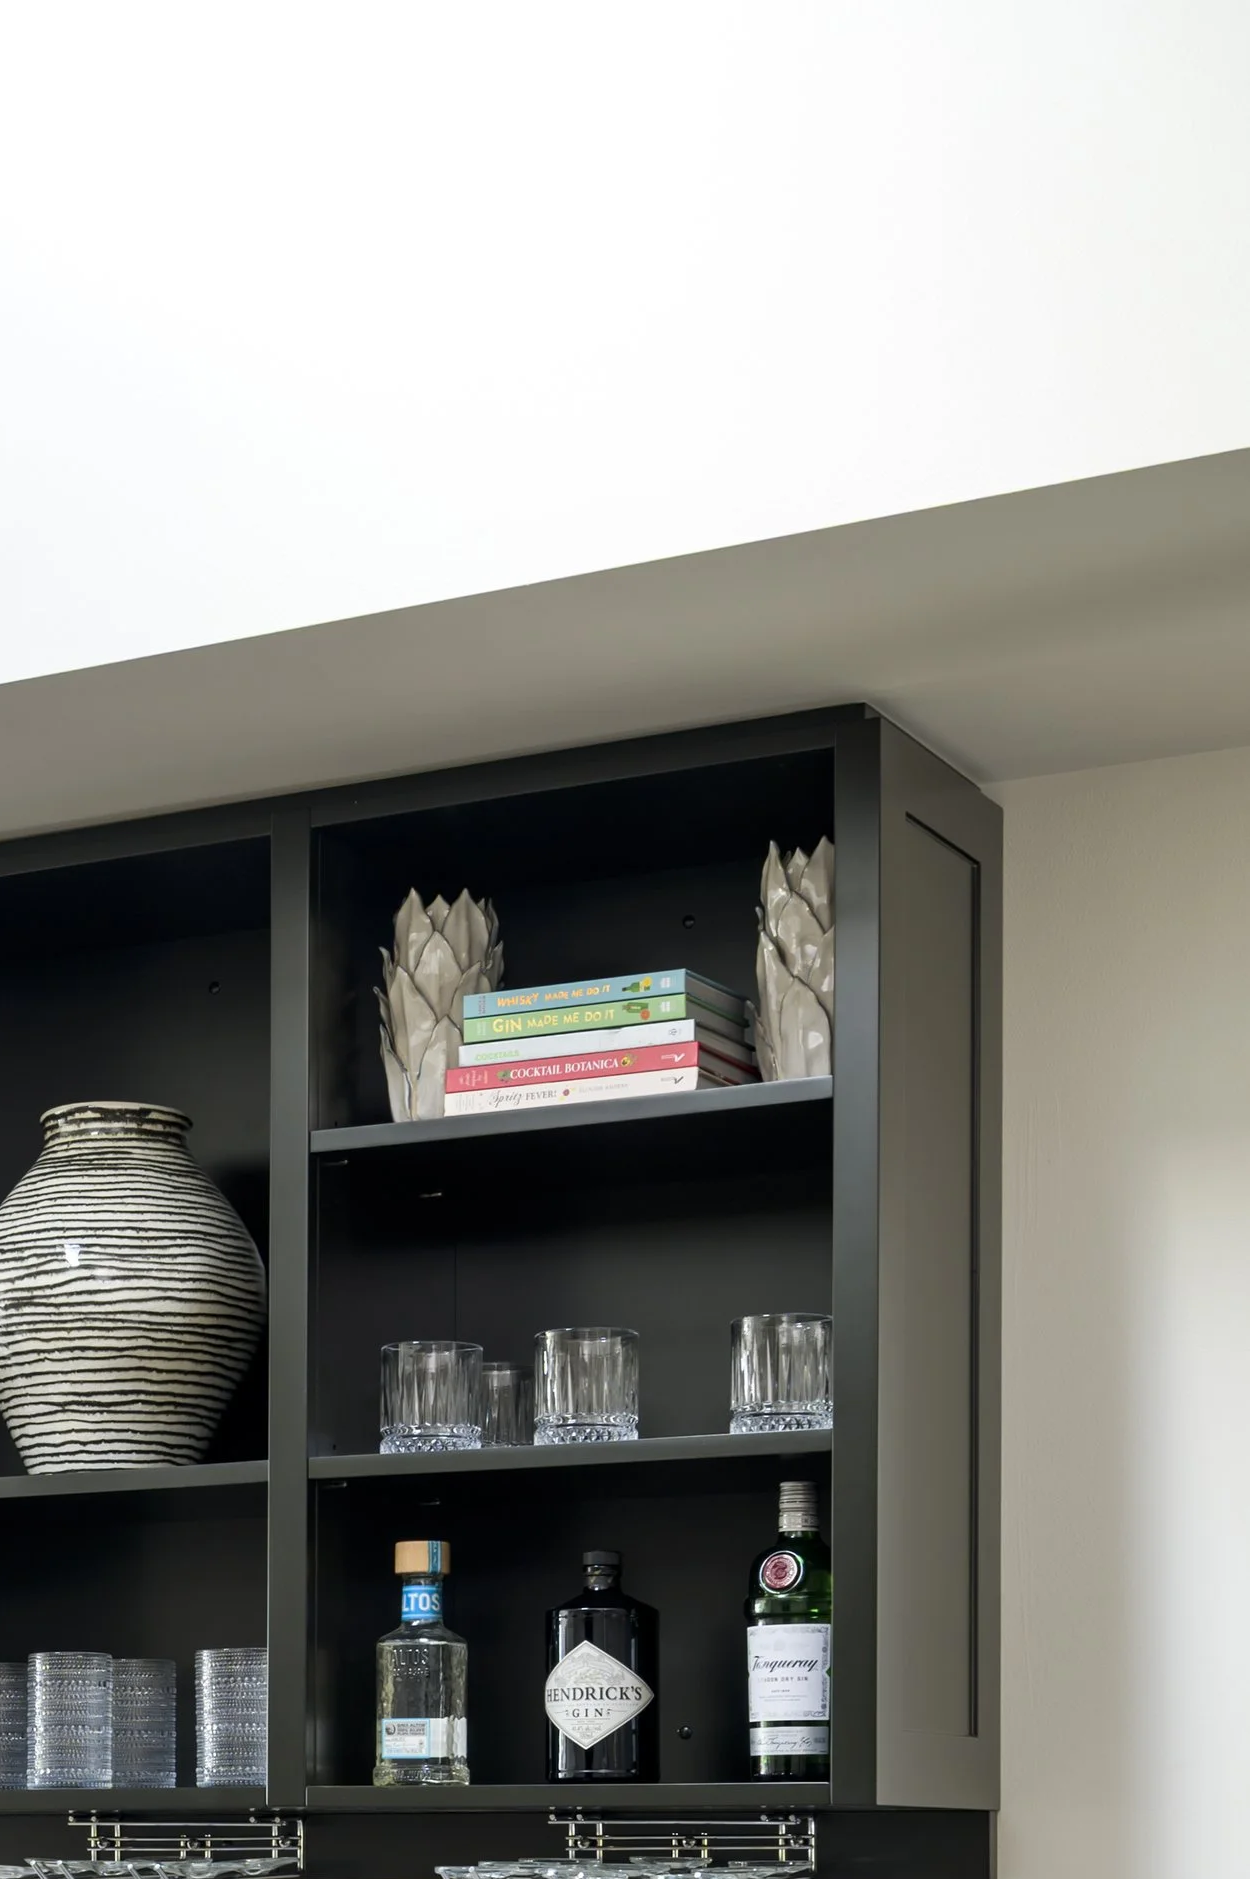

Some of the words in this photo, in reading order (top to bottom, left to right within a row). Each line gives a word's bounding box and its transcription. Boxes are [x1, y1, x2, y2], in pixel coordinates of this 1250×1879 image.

[497, 992, 539, 1007] WHISKY
[545, 991, 569, 1000] MADE
[572, 988, 583, 998] ME
[586, 987, 599, 996] DO
[602, 984, 611, 993] IT
[492, 1018, 522, 1033] GIN
[527, 1014, 558, 1028] MADE
[563, 1012, 580, 1023] ME
[585, 1011, 602, 1022] DO
[604, 1009, 615, 1020] IT
[510, 1064, 562, 1079] COCKTAIL
[564, 1058, 619, 1073] BOTANICA
[525, 1089, 557, 1101] FEVER!
[402, 1592, 440, 1611] LTOS
[752, 1655, 819, 1673] Tanqueray
[546, 1685, 643, 1703] HENDRICK'S
[571, 1708, 603, 1718] GIN
